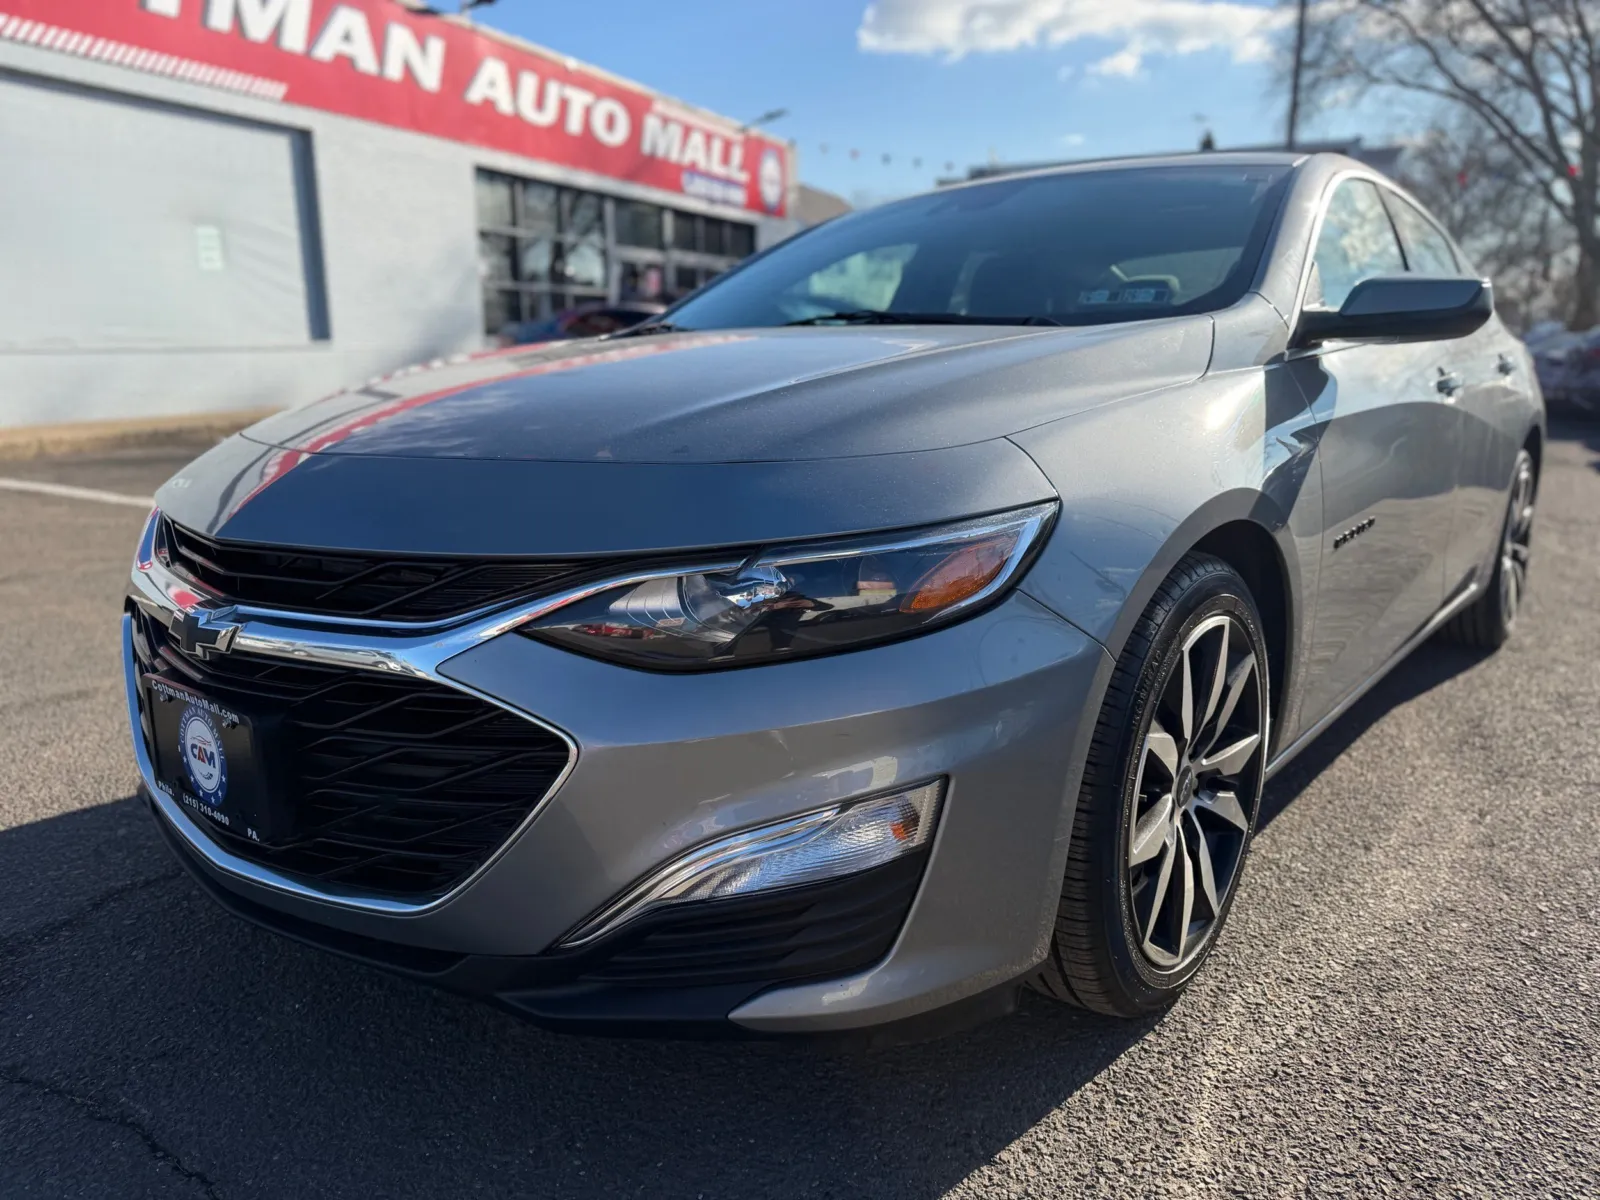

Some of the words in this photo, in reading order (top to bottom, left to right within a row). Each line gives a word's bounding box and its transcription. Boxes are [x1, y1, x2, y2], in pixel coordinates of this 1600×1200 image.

[145, 0, 445, 93] MAN
[464, 56, 631, 147] AUTO
[641, 112, 749, 183] MALL
[152, 680, 239, 724] CottmanAutoMall.com
[190, 742, 217, 769] CAM
[182, 792, 199, 810] (215)
[247, 827, 260, 842] PA.
